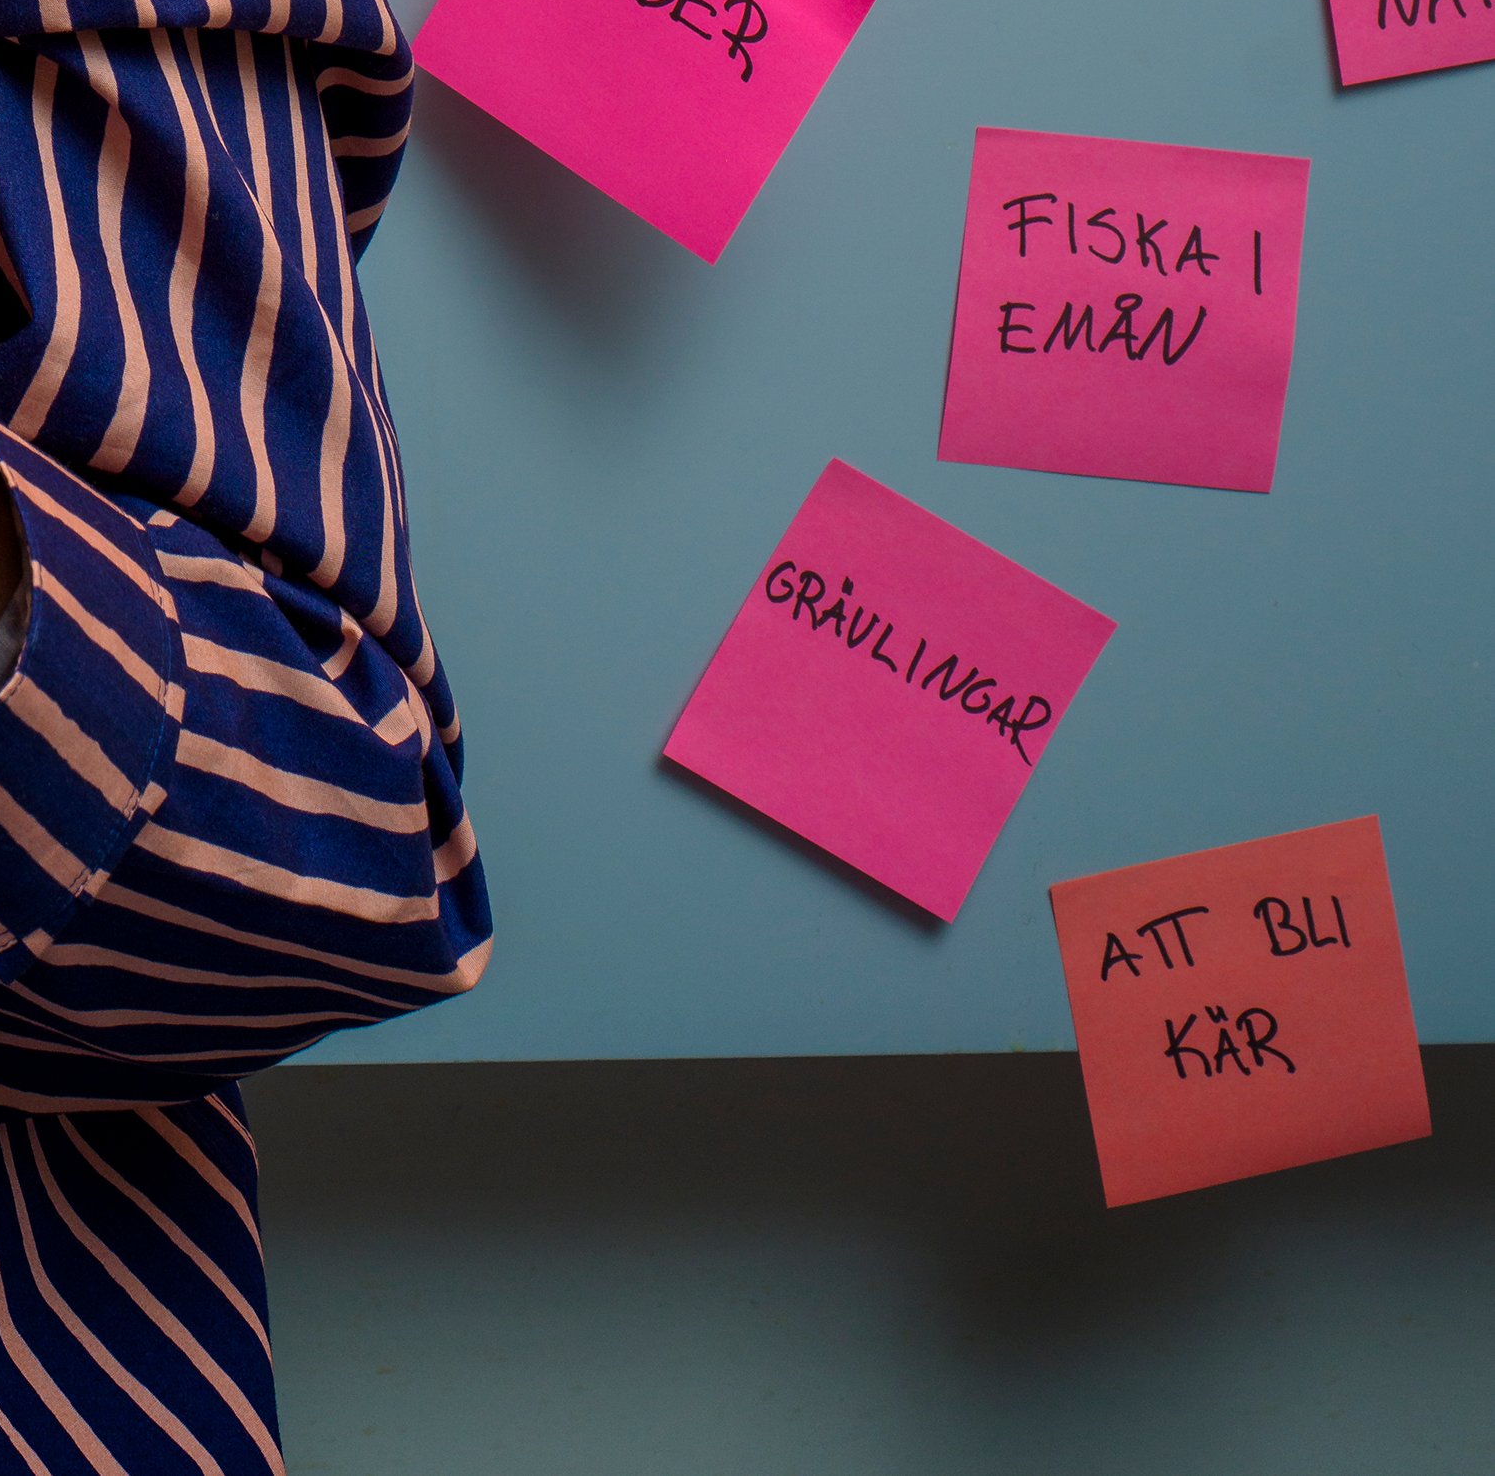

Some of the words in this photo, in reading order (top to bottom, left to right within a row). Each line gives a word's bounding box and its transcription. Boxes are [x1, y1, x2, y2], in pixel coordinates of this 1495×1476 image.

[1003, 191, 1219, 279] FISKA
[1250, 227, 1265, 297] I
[999, 292, 1208, 366] EMÅN
[1101, 905, 1209, 982] ATT
[1254, 894, 1352, 956] BLI
[1164, 1003, 1296, 1080] KÄR
